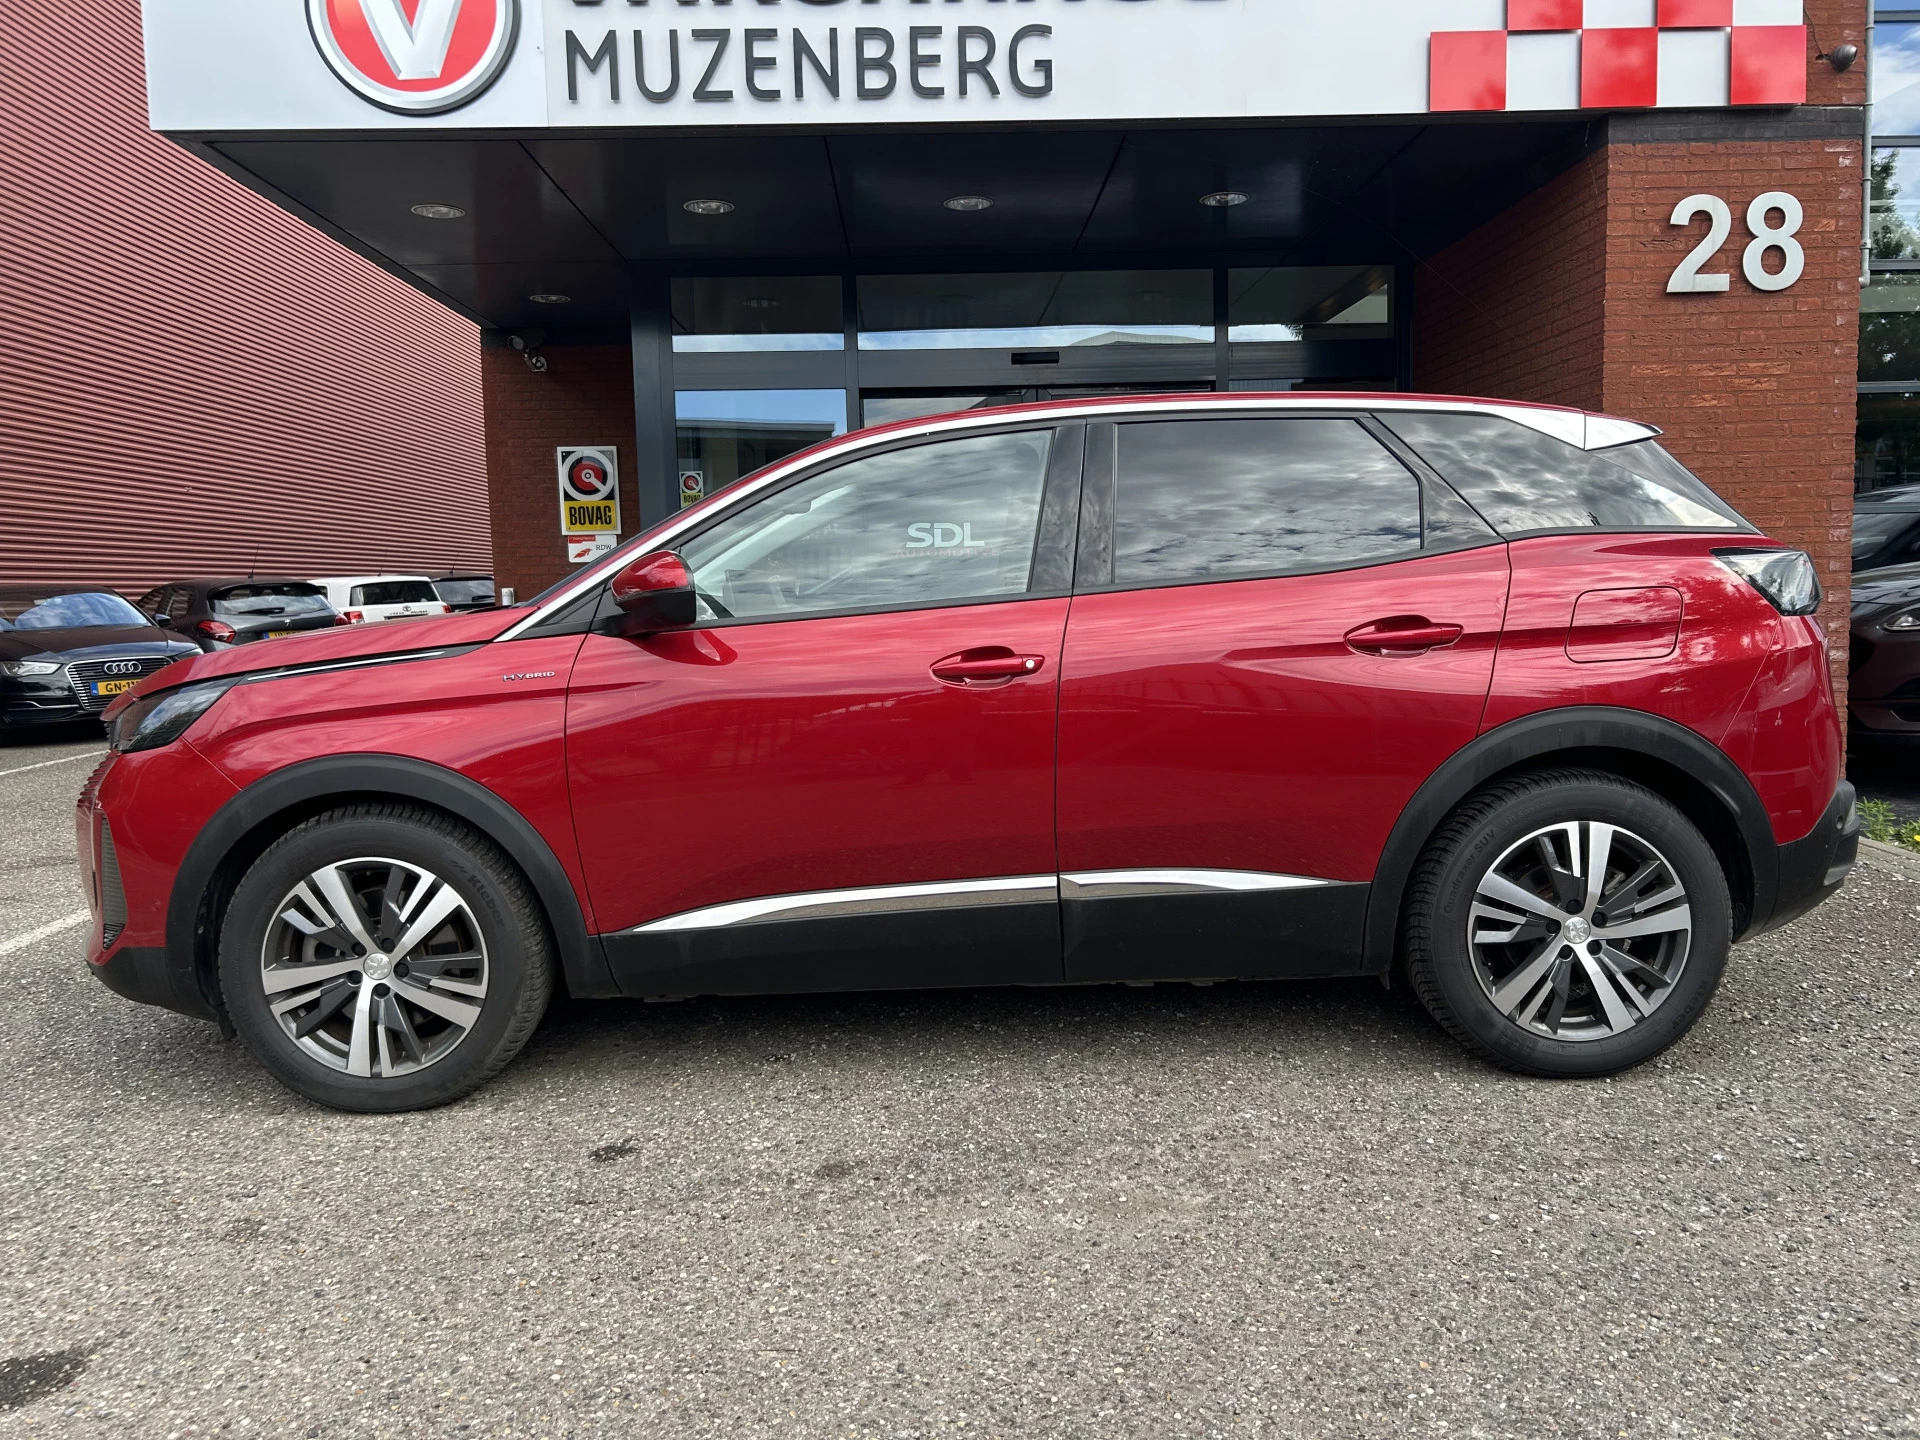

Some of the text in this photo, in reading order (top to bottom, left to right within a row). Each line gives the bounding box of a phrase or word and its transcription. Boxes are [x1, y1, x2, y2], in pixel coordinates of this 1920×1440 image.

[565, 23, 1053, 100] MUZENBERG
[1666, 191, 1804, 293] 28
[569, 505, 612, 525] BOVAG
[906, 522, 985, 548] SDL
[896, 547, 1000, 558] AUTOMOTIVE
[503, 671, 556, 682] HYBRID
[467, 874, 505, 927] Kleber
